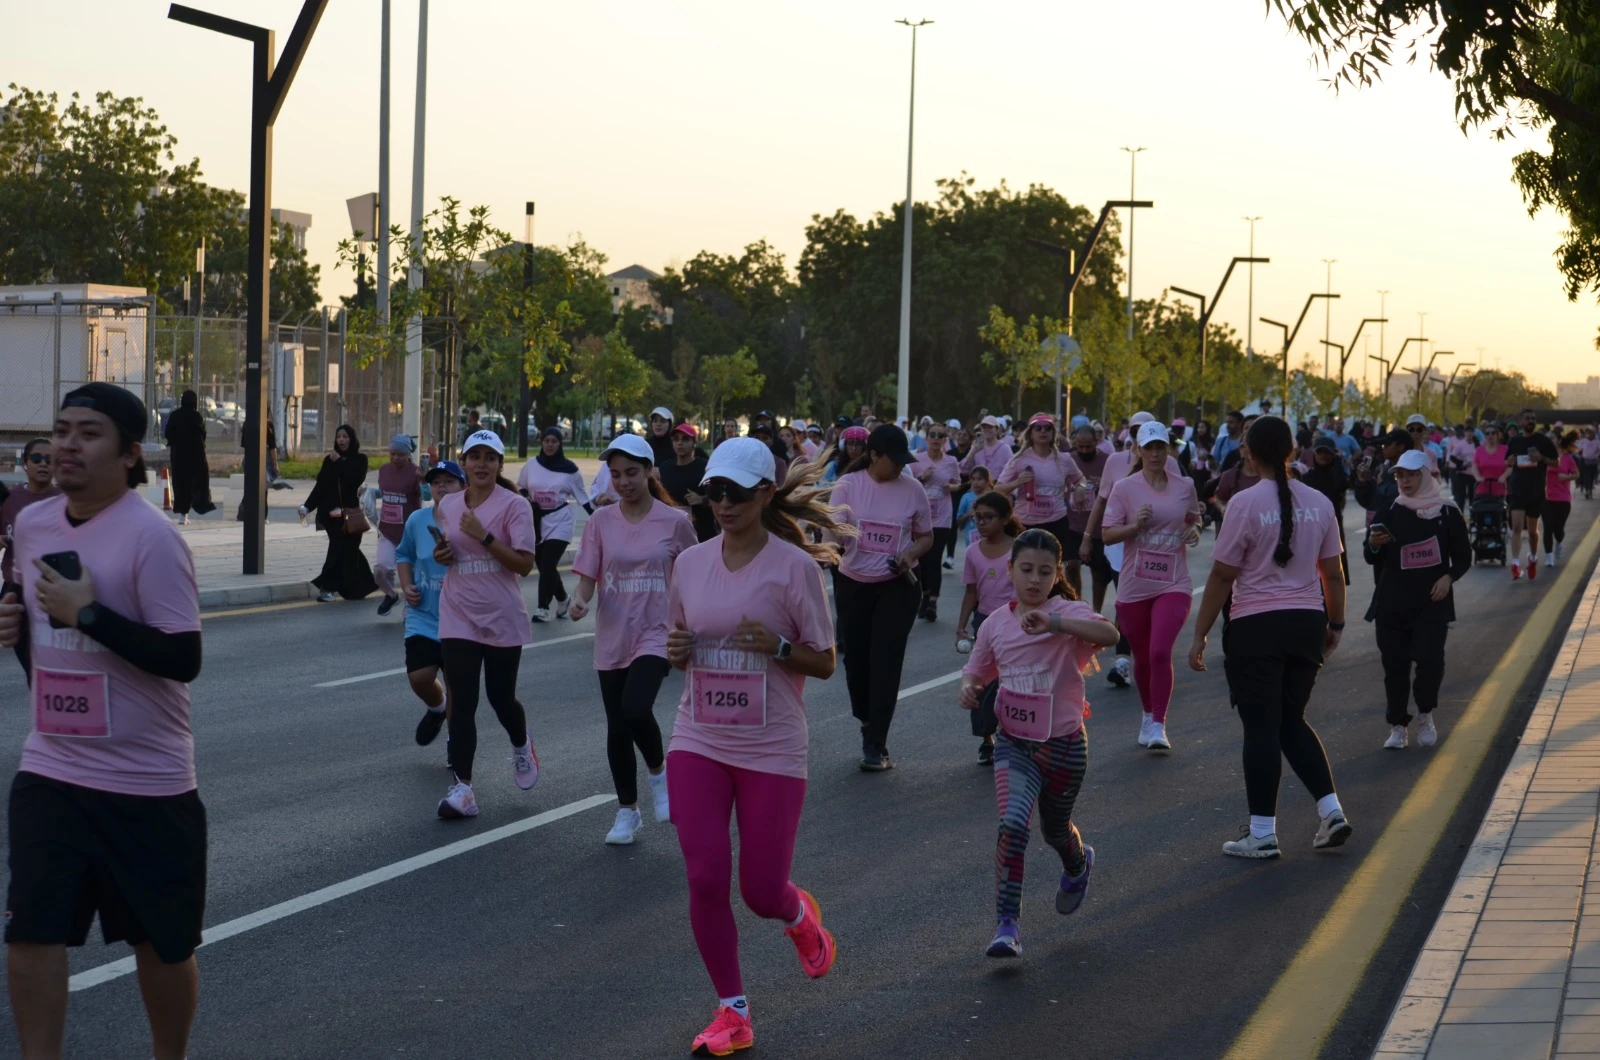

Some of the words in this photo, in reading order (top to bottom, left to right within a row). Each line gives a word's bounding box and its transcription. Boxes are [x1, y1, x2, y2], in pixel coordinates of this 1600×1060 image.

[867, 531, 892, 543] 1167
[458, 561, 473, 575] PINK
[473, 560, 489, 574] STEP
[1144, 561, 1168, 572] 1258
[618, 579, 634, 593] PINK
[634, 578, 651, 593] STEP
[651, 578, 666, 593] RUN
[696, 647, 719, 668] PINK
[719, 649, 745, 670] STEP
[747, 651, 768, 670] RUN
[44, 694, 90, 714] 1028
[705, 690, 749, 707] 1256
[1004, 705, 1036, 723] 1251
